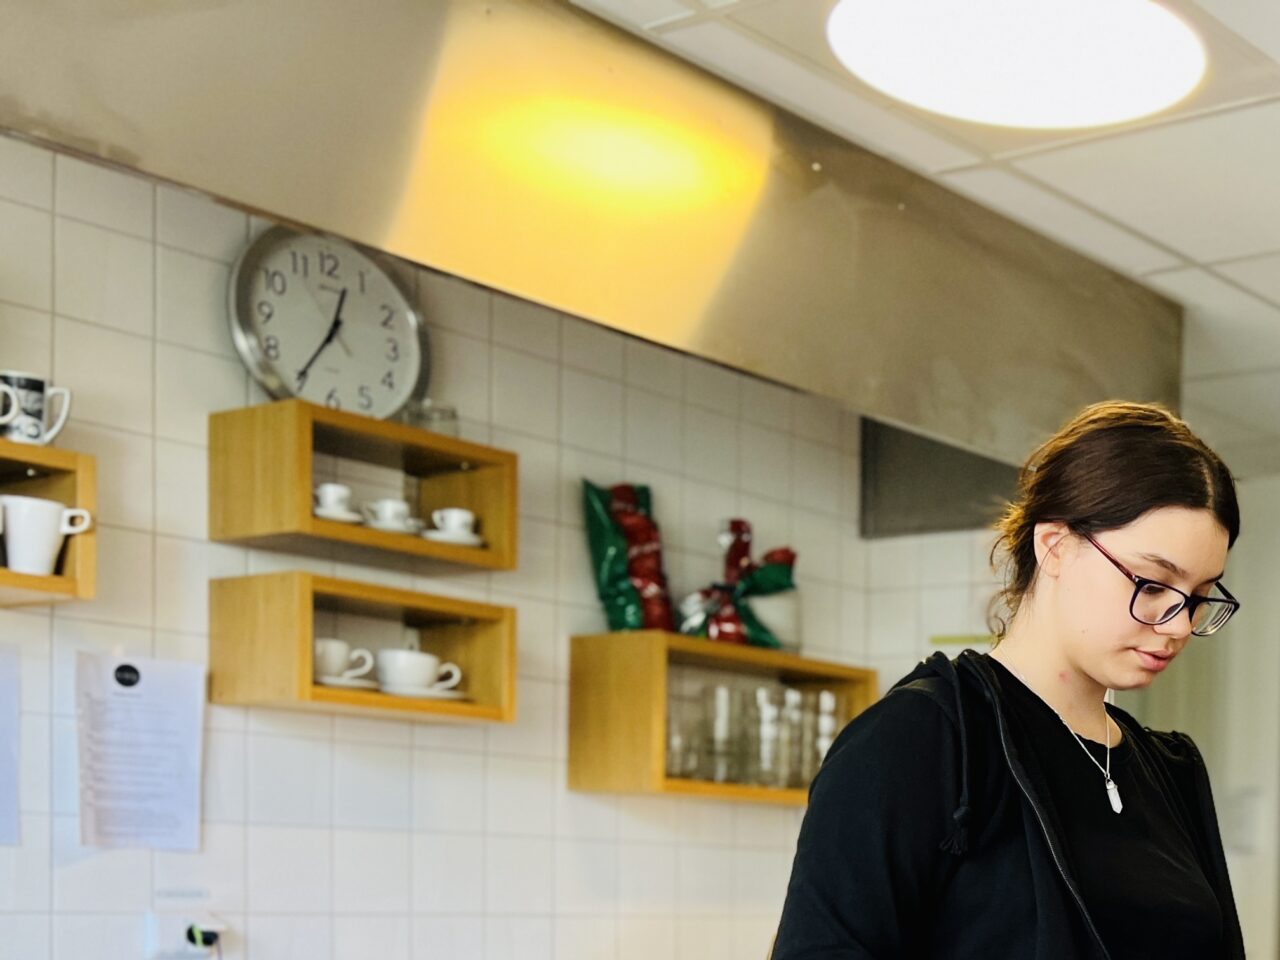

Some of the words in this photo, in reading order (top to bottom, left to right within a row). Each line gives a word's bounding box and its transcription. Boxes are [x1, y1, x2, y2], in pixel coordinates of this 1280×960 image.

[291, 251, 309, 278] 11
[319, 251, 340, 279] 12
[264, 268, 287, 296] 10
[358, 270, 366, 294] 1
[257, 301, 274, 324] 9
[380, 304, 396, 328] 2
[264, 336, 280, 361] 8
[386, 338, 400, 361] 3
[380, 371, 395, 390] 4
[325, 387, 341, 411] 6
[358, 385, 373, 410] 5
